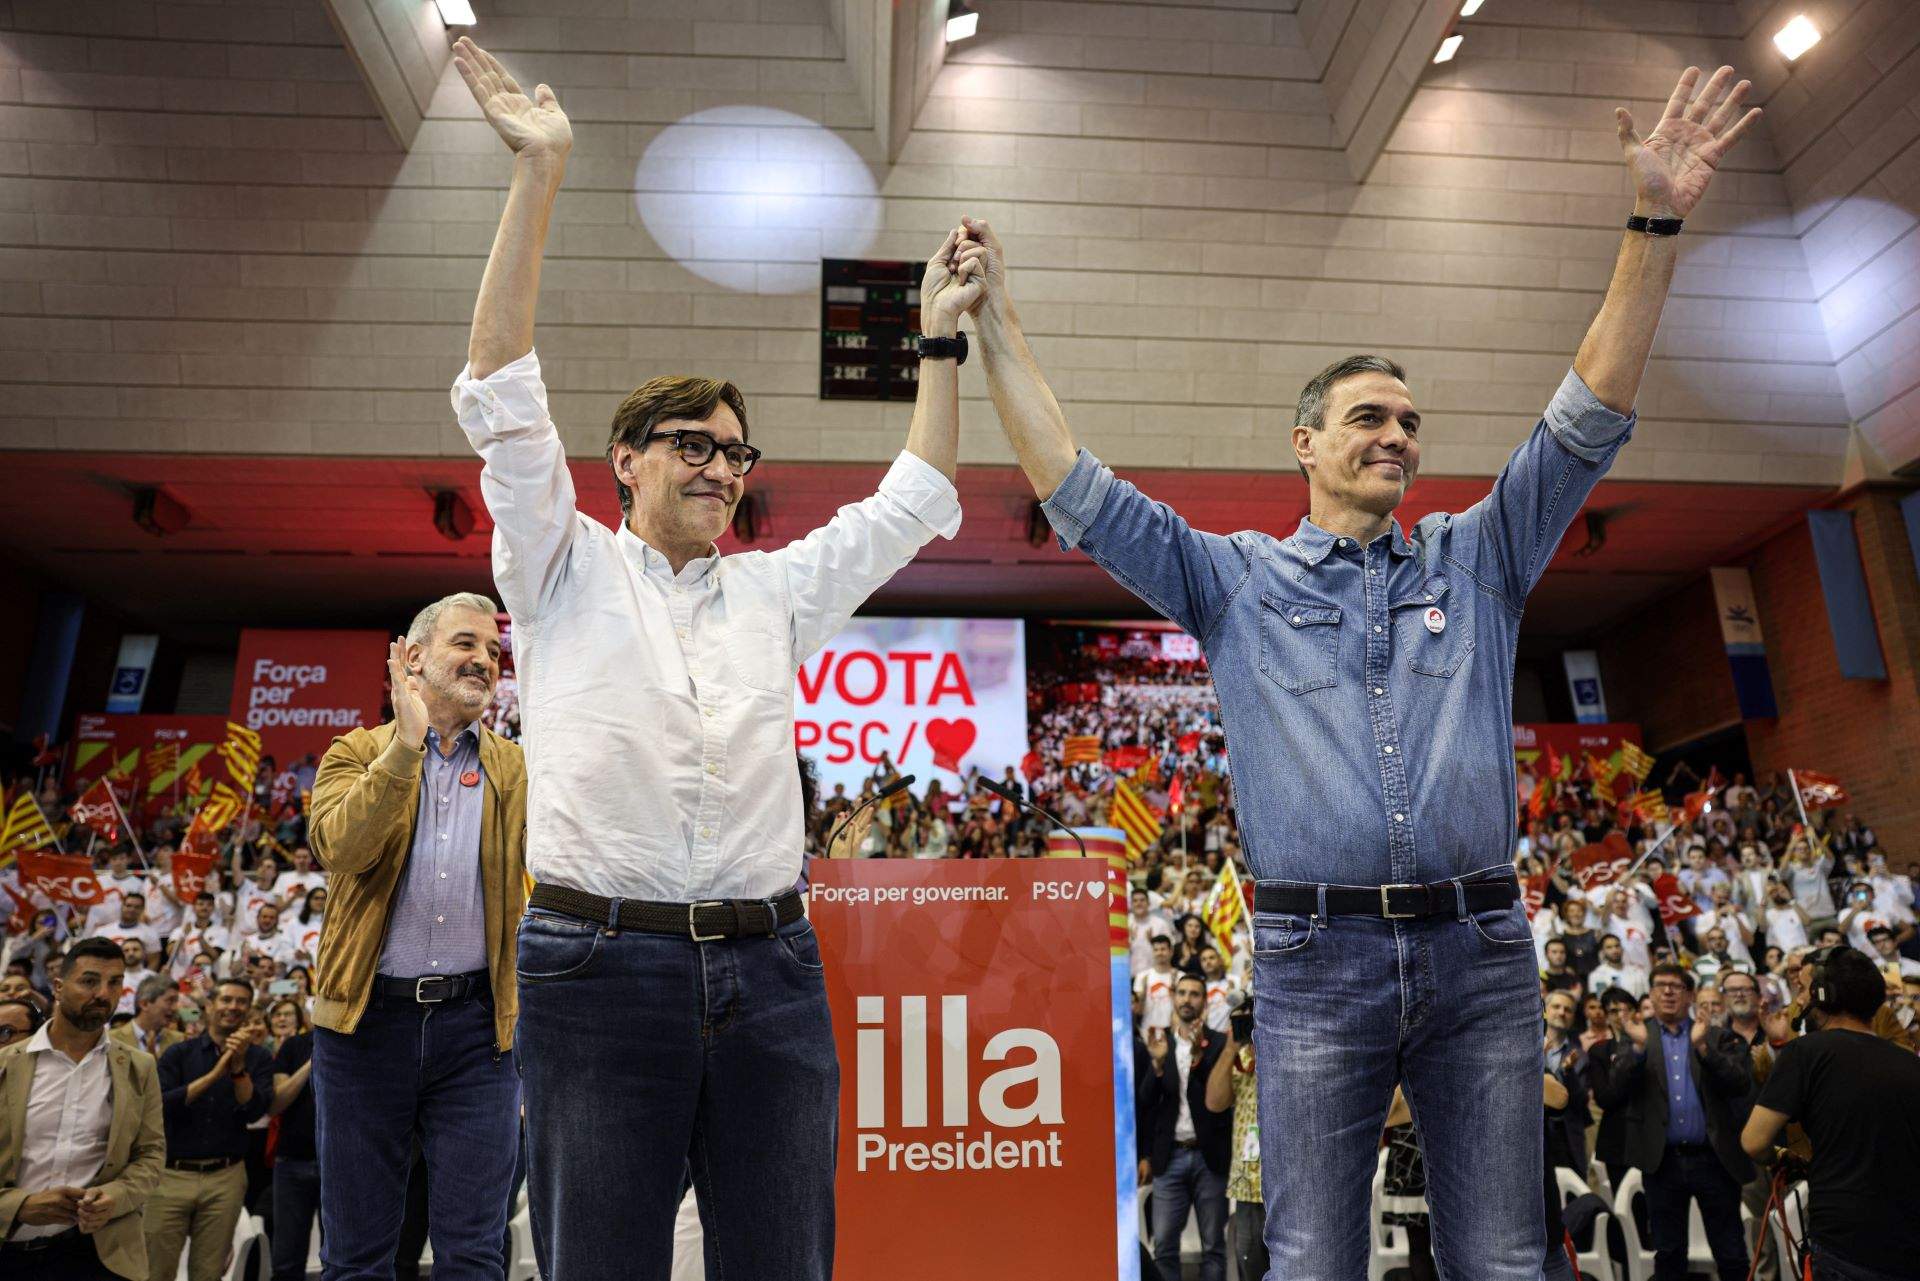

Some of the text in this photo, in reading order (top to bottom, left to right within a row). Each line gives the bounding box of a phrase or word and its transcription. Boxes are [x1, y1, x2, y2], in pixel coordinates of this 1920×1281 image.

[253, 659, 327, 688] Força
[796, 650, 975, 706] VOTA
[249, 685, 295, 709] per
[246, 707, 364, 731] governar.
[36, 875, 96, 900] PSC
[1577, 857, 1632, 890] PSC
[811, 883, 1009, 906] Força per governar.
[856, 994, 1066, 1128] illa
[857, 1131, 1063, 1172] President
